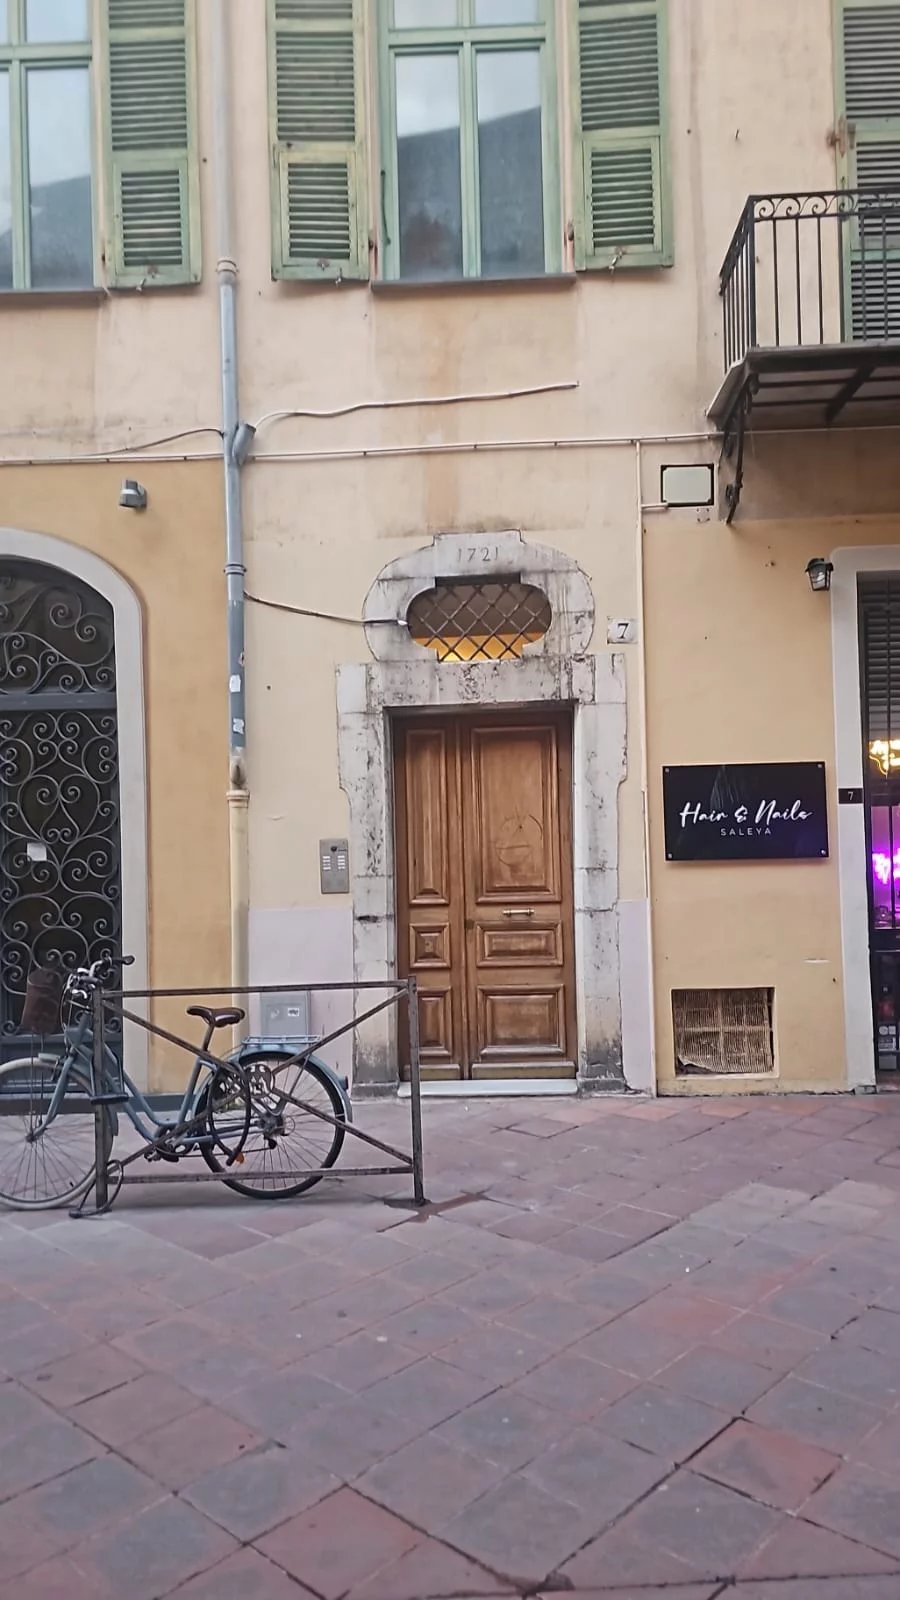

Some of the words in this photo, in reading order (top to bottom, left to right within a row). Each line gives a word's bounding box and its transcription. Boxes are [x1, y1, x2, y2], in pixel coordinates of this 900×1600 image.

[457, 546, 499, 562] 1721
[617, 622, 630, 639] 7
[847, 791, 854, 801] 7
[679, 801, 728, 828] Hair
[734, 805, 749, 823] &
[755, 799, 813, 825] Nails
[720, 827, 772, 836] SALEYA
